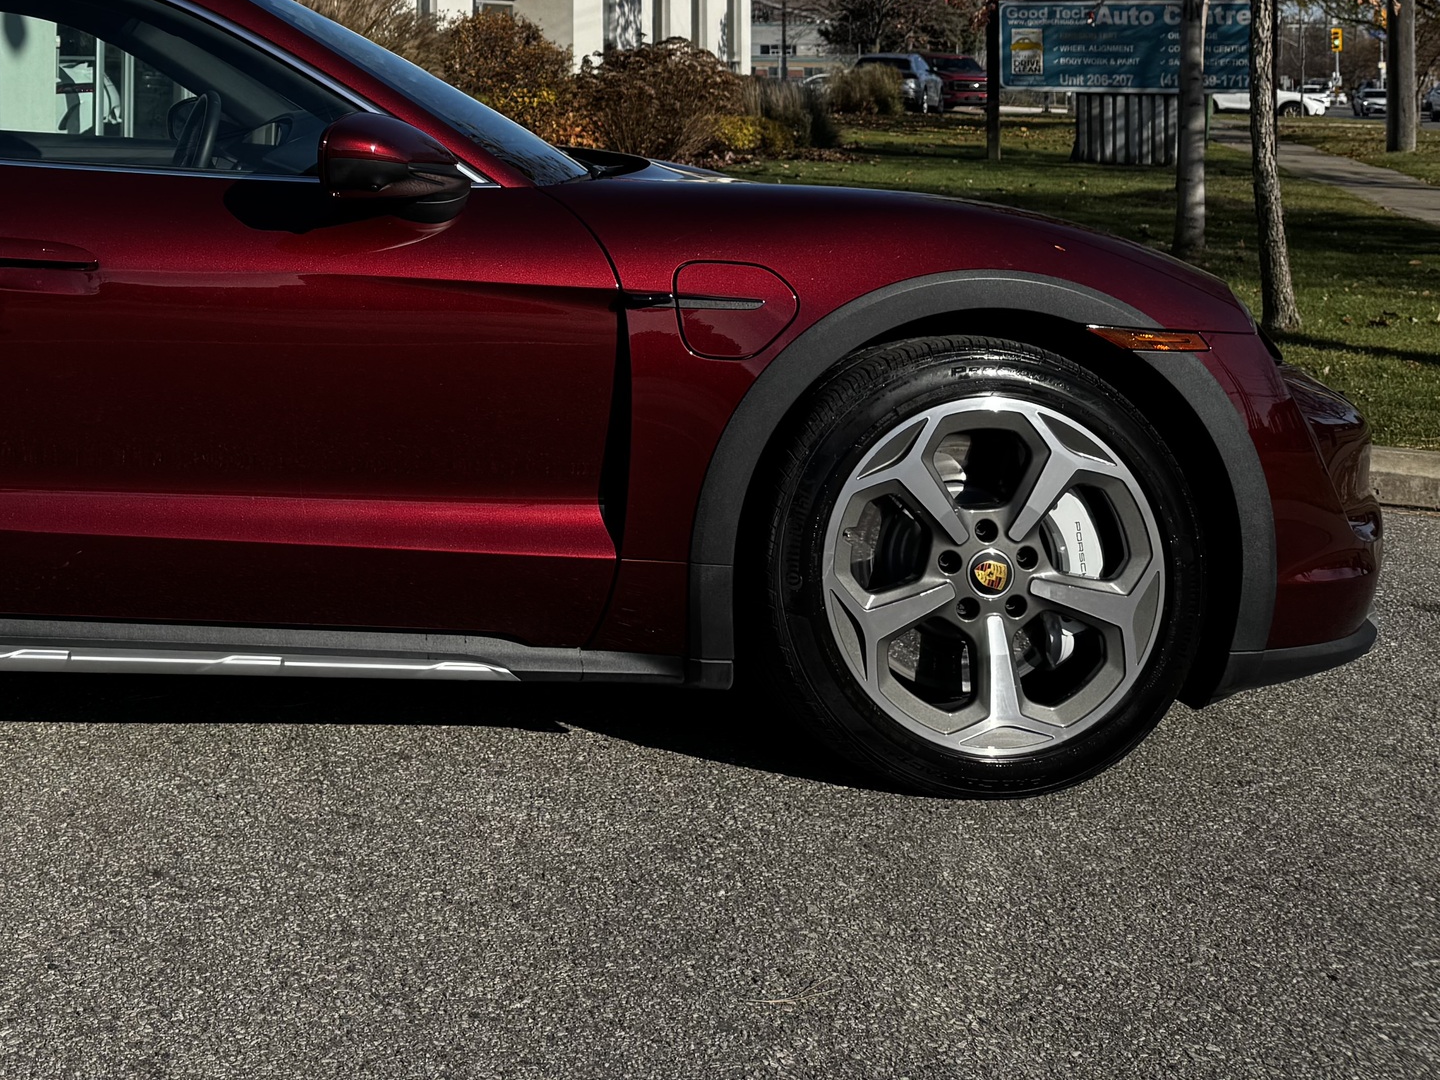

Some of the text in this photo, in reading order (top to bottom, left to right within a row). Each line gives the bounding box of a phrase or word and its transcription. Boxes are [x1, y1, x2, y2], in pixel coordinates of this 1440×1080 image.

[1006, 5, 1251, 26] Good Tech Auto Ctre
[1060, 45, 1134, 53] WHEEL ALIGNMENT
[1060, 57, 1082, 65] BODY
[1083, 57, 1108, 65] WORK
[1117, 57, 1140, 65] PAINT
[1059, 73, 1084, 86] Unit
[1086, 73, 1134, 87] 206-207
[1202, 74, 1250, 88] 39-1717
